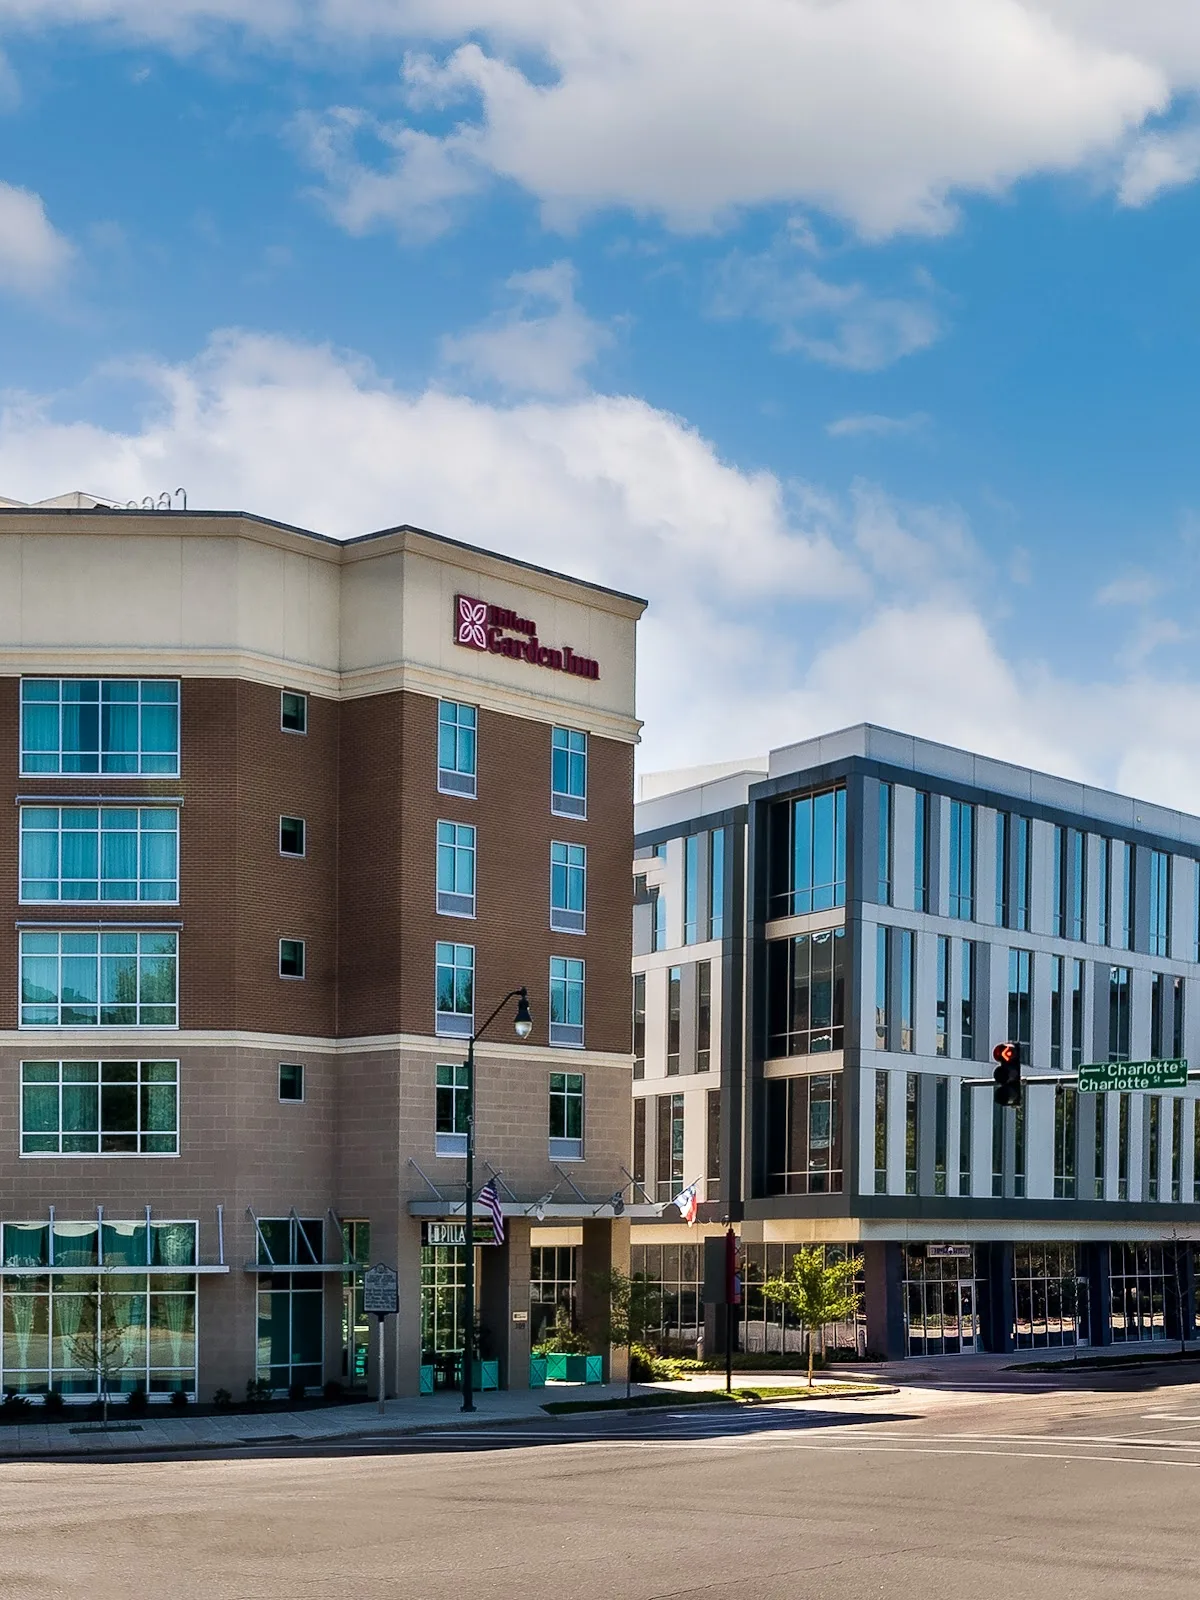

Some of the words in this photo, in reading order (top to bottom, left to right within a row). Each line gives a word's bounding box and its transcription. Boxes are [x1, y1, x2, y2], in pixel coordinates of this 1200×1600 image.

[488, 604, 537, 636] Hilton
[488, 627, 562, 671] Garden
[562, 646, 600, 680] Inn
[1107, 1062, 1179, 1077] Charlotte
[1079, 1077, 1149, 1091] Charlotte
[441, 1225, 467, 1242] PILLA
